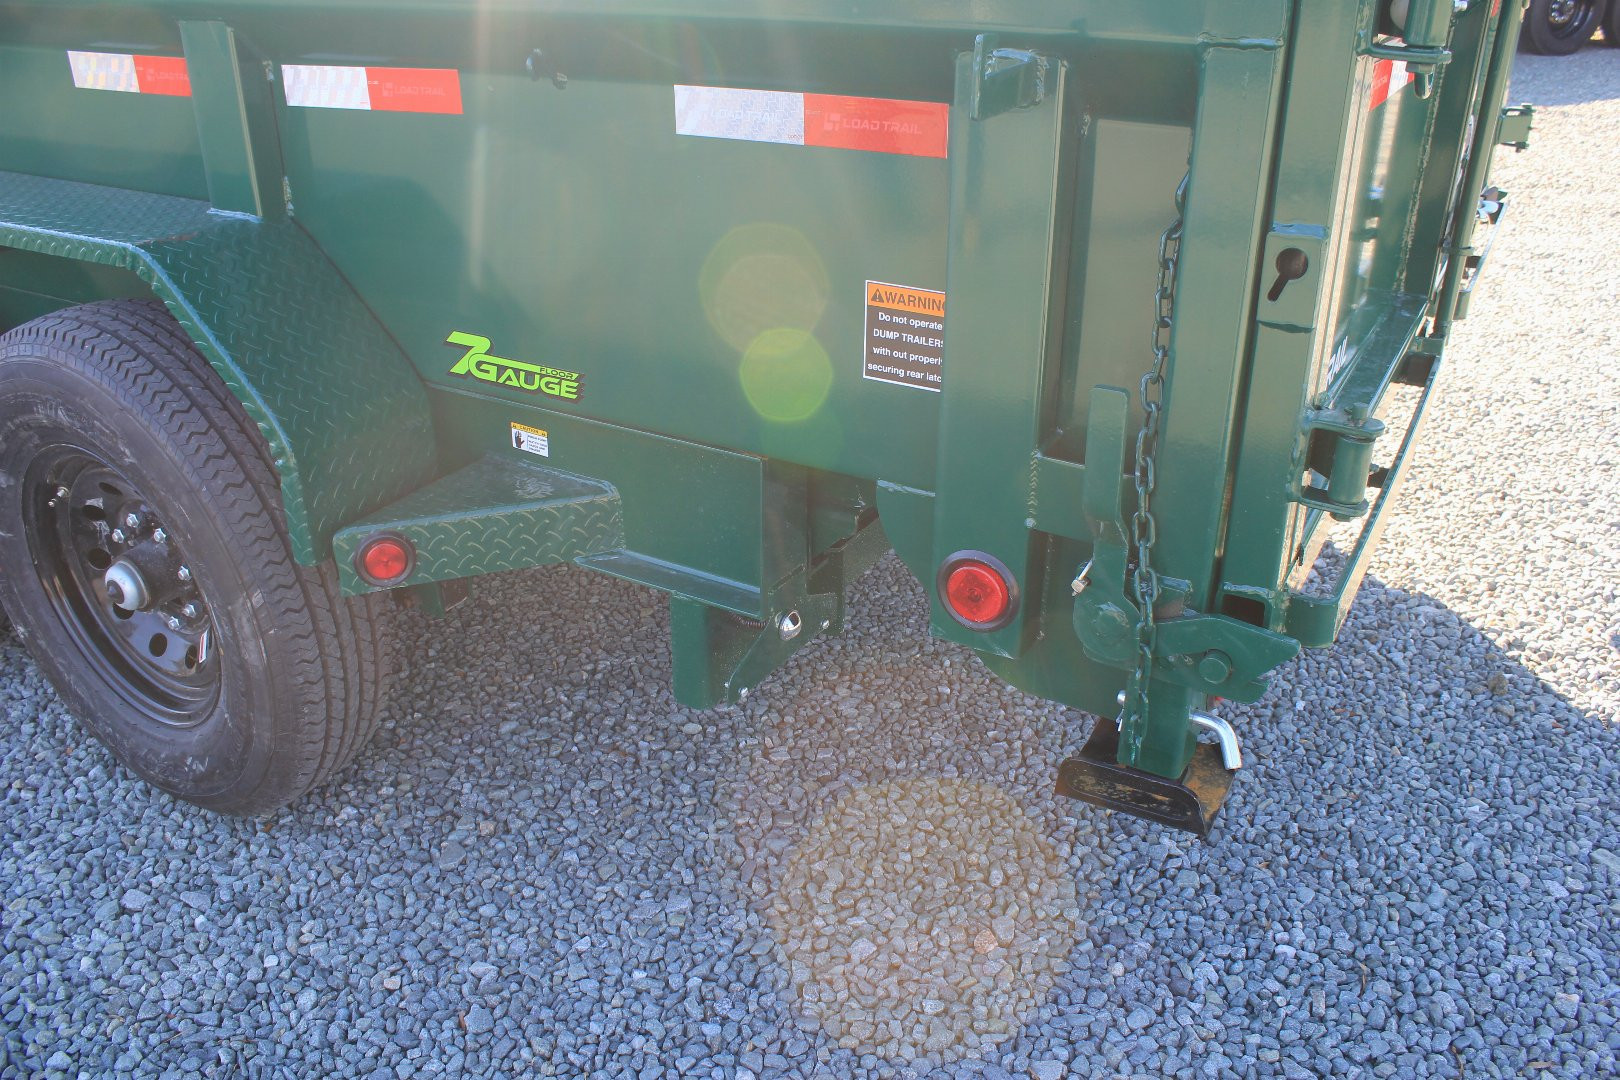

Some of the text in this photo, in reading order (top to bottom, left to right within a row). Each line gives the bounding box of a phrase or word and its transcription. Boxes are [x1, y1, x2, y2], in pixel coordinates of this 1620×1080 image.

[843, 118, 922, 135] LOAD TRAIL
[878, 311, 943, 331] Do not operate
[873, 328, 899, 340] DUMP
[446, 331, 579, 399] 7 GAUGE
[873, 346, 943, 367] with out properl
[539, 367, 574, 380] FLOOR
[867, 363, 904, 378] securing
[907, 369, 924, 379] rear
